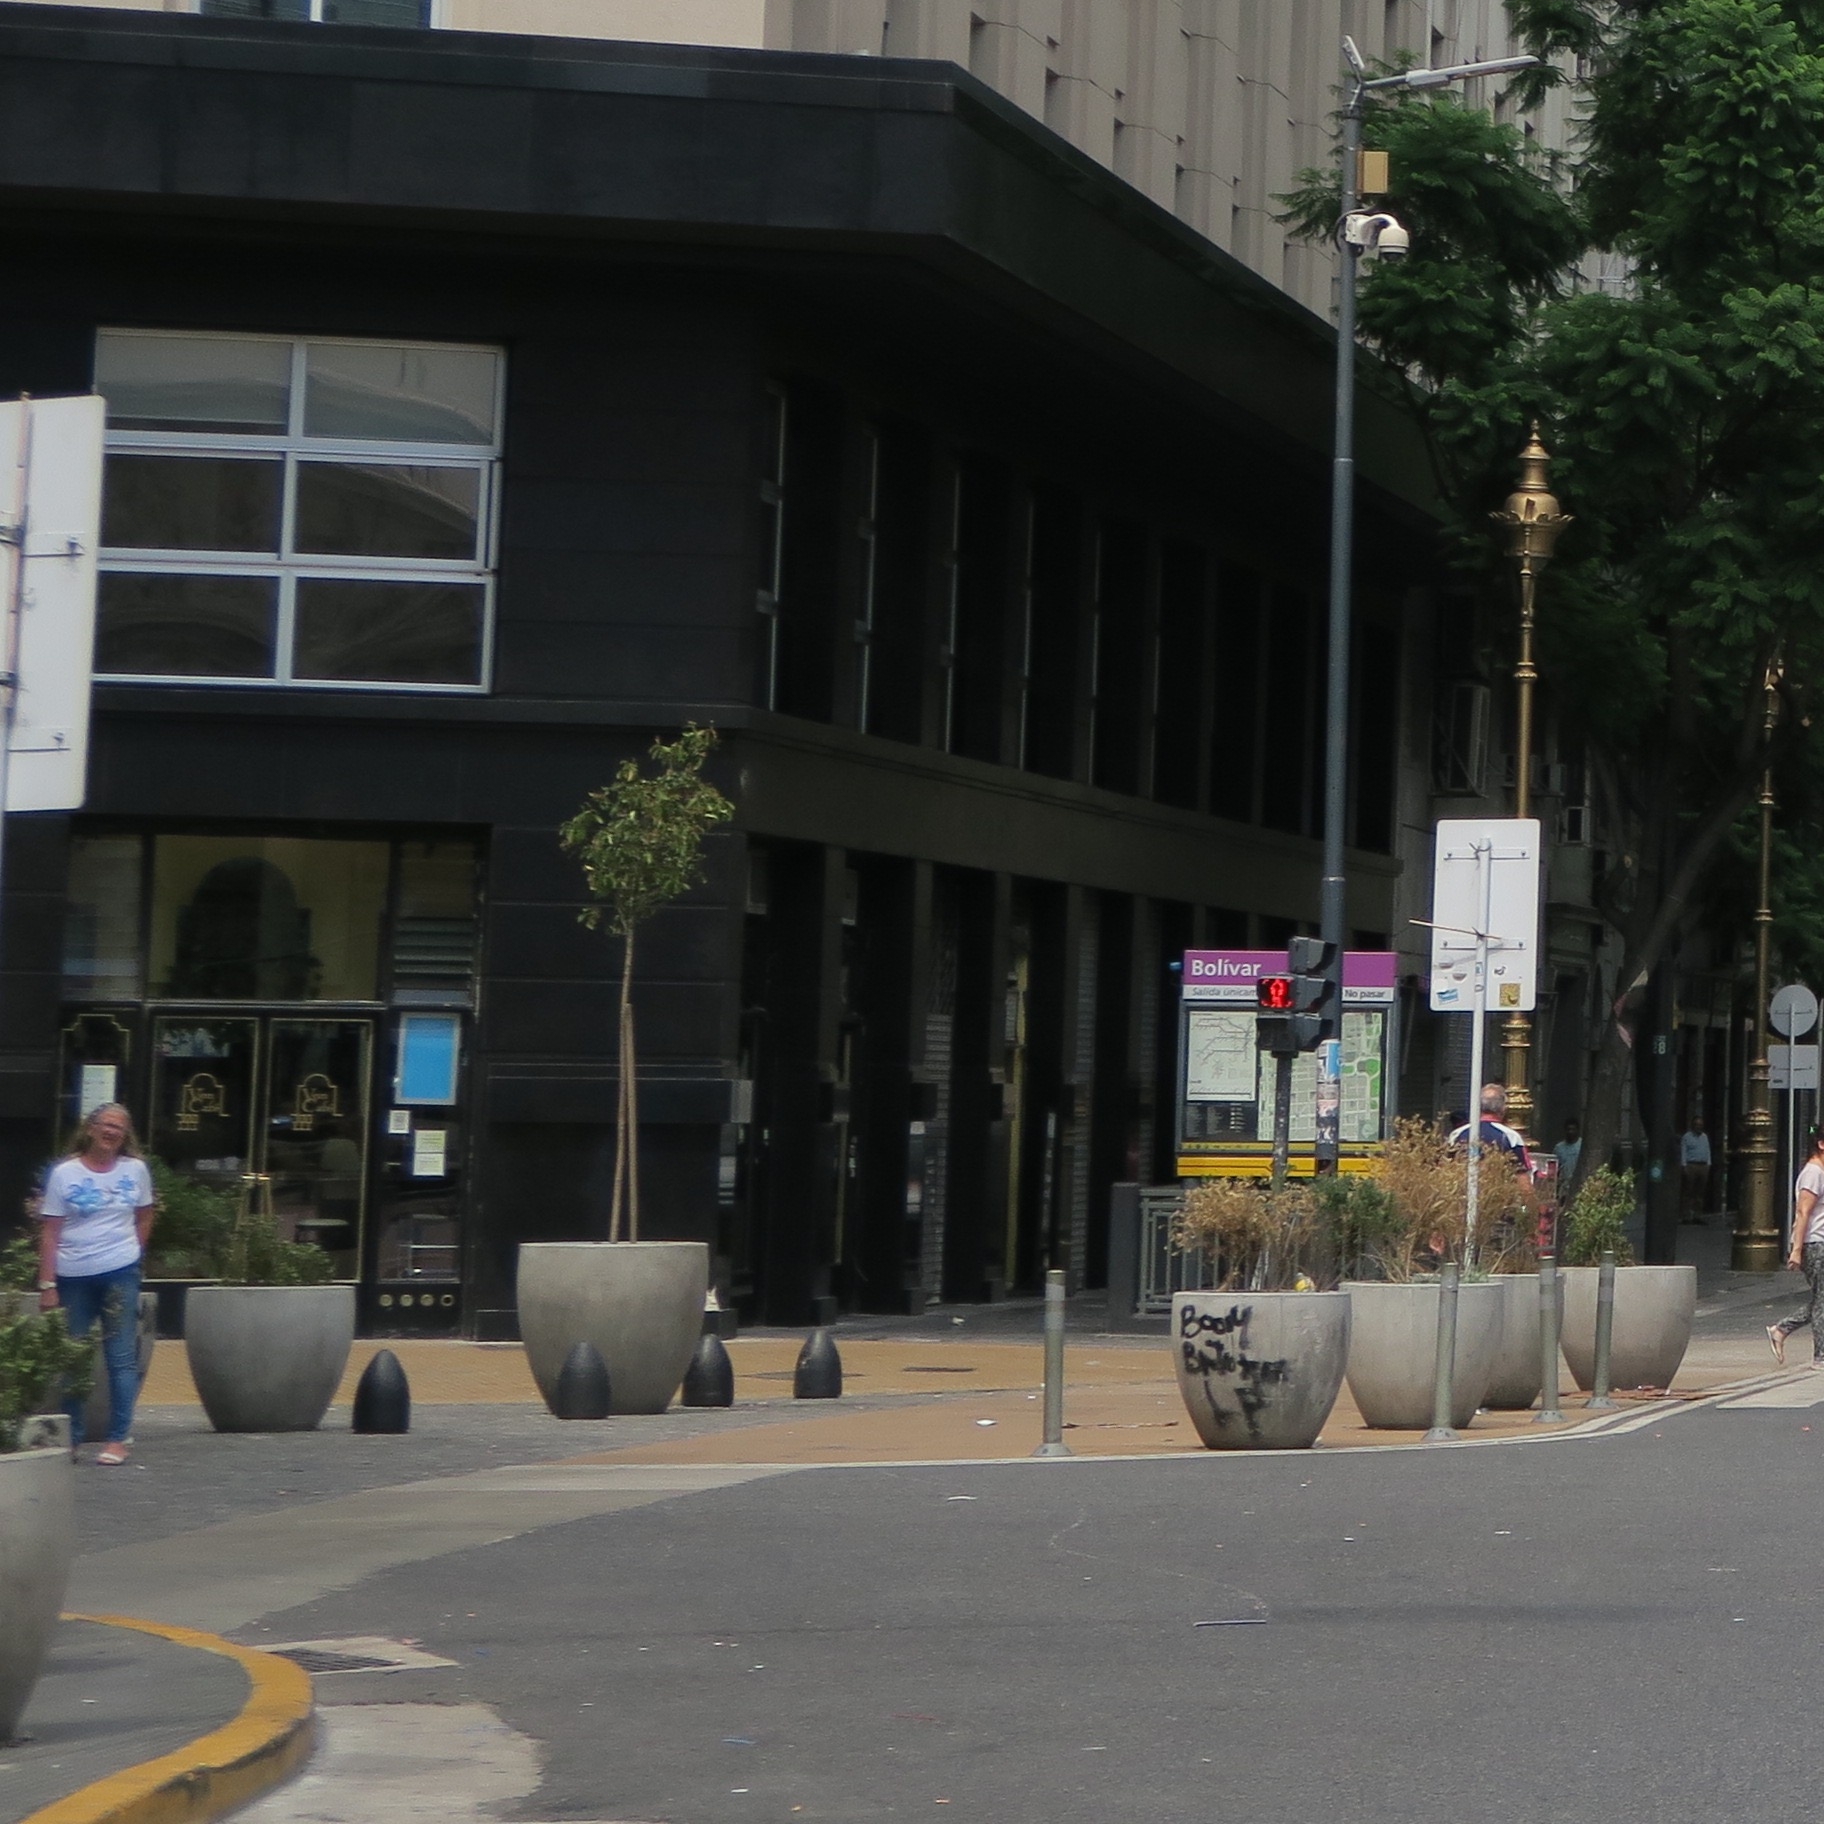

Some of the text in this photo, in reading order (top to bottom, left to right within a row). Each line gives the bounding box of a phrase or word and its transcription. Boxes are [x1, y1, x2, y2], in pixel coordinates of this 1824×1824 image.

[1191, 959, 1262, 976] Bolívar
[1192, 986, 1385, 999] Salida únicam No pasar
